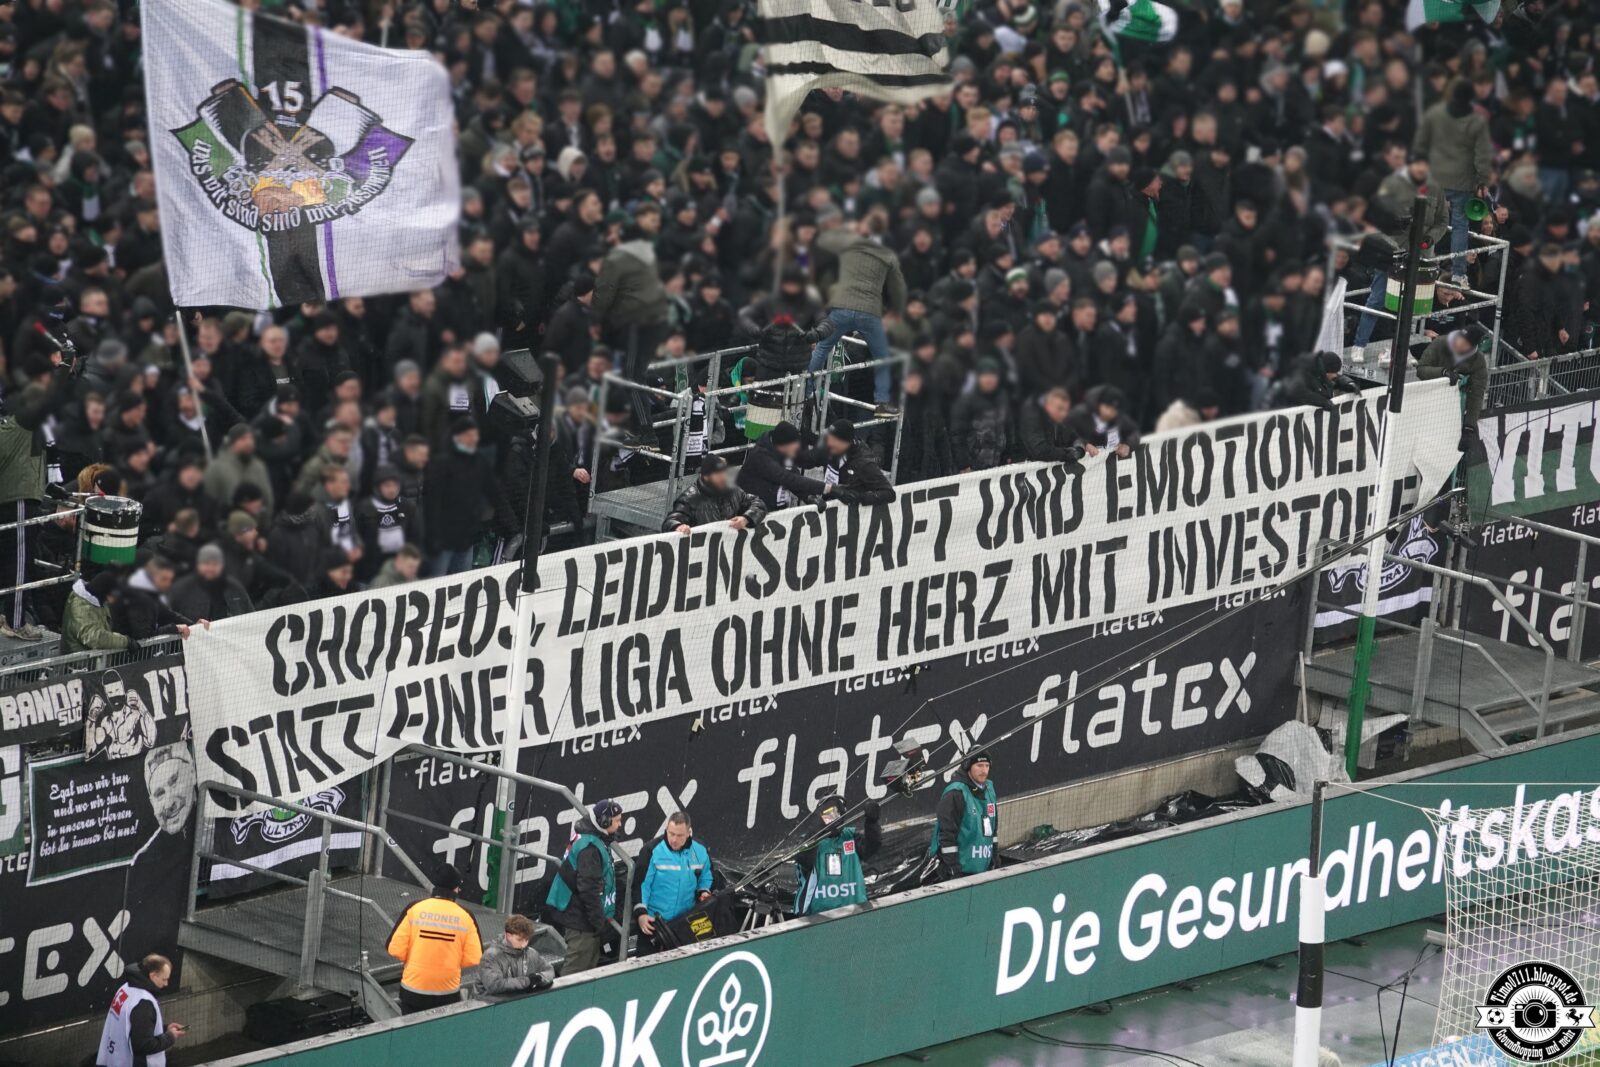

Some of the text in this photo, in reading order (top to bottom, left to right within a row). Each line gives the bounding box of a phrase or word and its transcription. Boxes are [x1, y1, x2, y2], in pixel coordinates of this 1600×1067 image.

[260, 80, 304, 112] 15
[226, 200, 259, 228] sind
[262, 206, 301, 232] sind
[557, 483, 959, 636] LEIDENSCHAFT
[976, 460, 1086, 550] UND
[1105, 392, 1387, 525] EMOTIONEN
[206, 693, 377, 811] STATT
[387, 657, 551, 750] EINER
[570, 628, 693, 728] LIGA
[711, 593, 859, 697] OHNE
[876, 559, 1013, 661] HERZ
[1031, 535, 1128, 629] MIT
[0, 678, 83, 731] BANDA
[49, 772, 130, 804] Egal was wir tun
[53, 798, 75, 818] und
[75, 802, 90, 813] wo
[90, 794, 106, 810] wir
[40, 819, 139, 857] bist du immer bei uns!
[47, 824, 58, 838] in
[59, 818, 97, 835] unseren
[814, 882, 857, 899] HOST
[419, 911, 460, 924] ORDNER
[995, 892, 1100, 996] Die
[510, 988, 679, 1067] AOK
